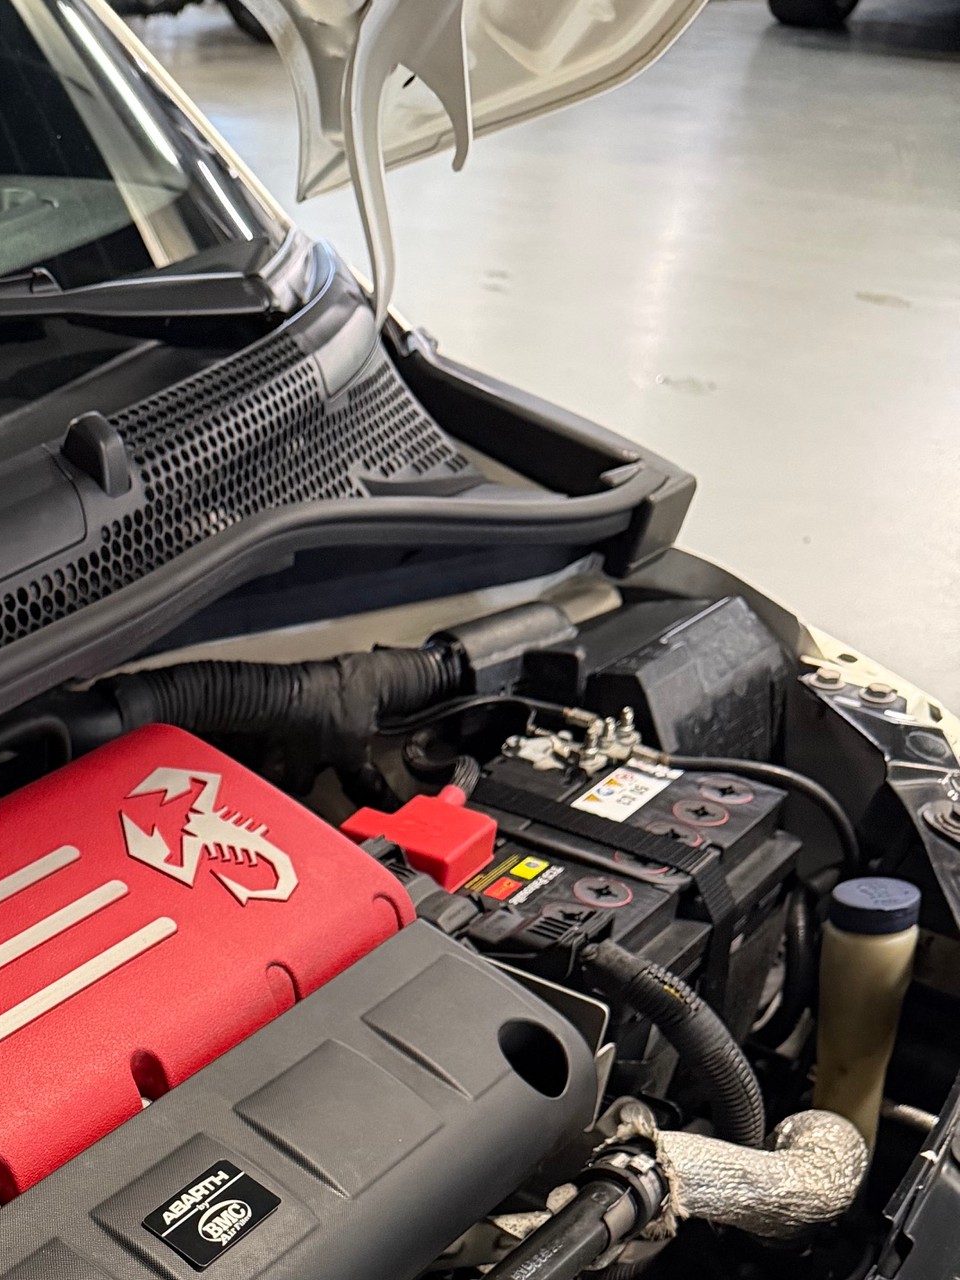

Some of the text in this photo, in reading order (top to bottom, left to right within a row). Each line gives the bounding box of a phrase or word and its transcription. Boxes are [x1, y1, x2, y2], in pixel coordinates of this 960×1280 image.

[161, 1170, 231, 1226] ABARTH
[195, 1201, 210, 1211] by
[202, 1203, 247, 1239] BMC
[220, 1227, 237, 1246] Air
